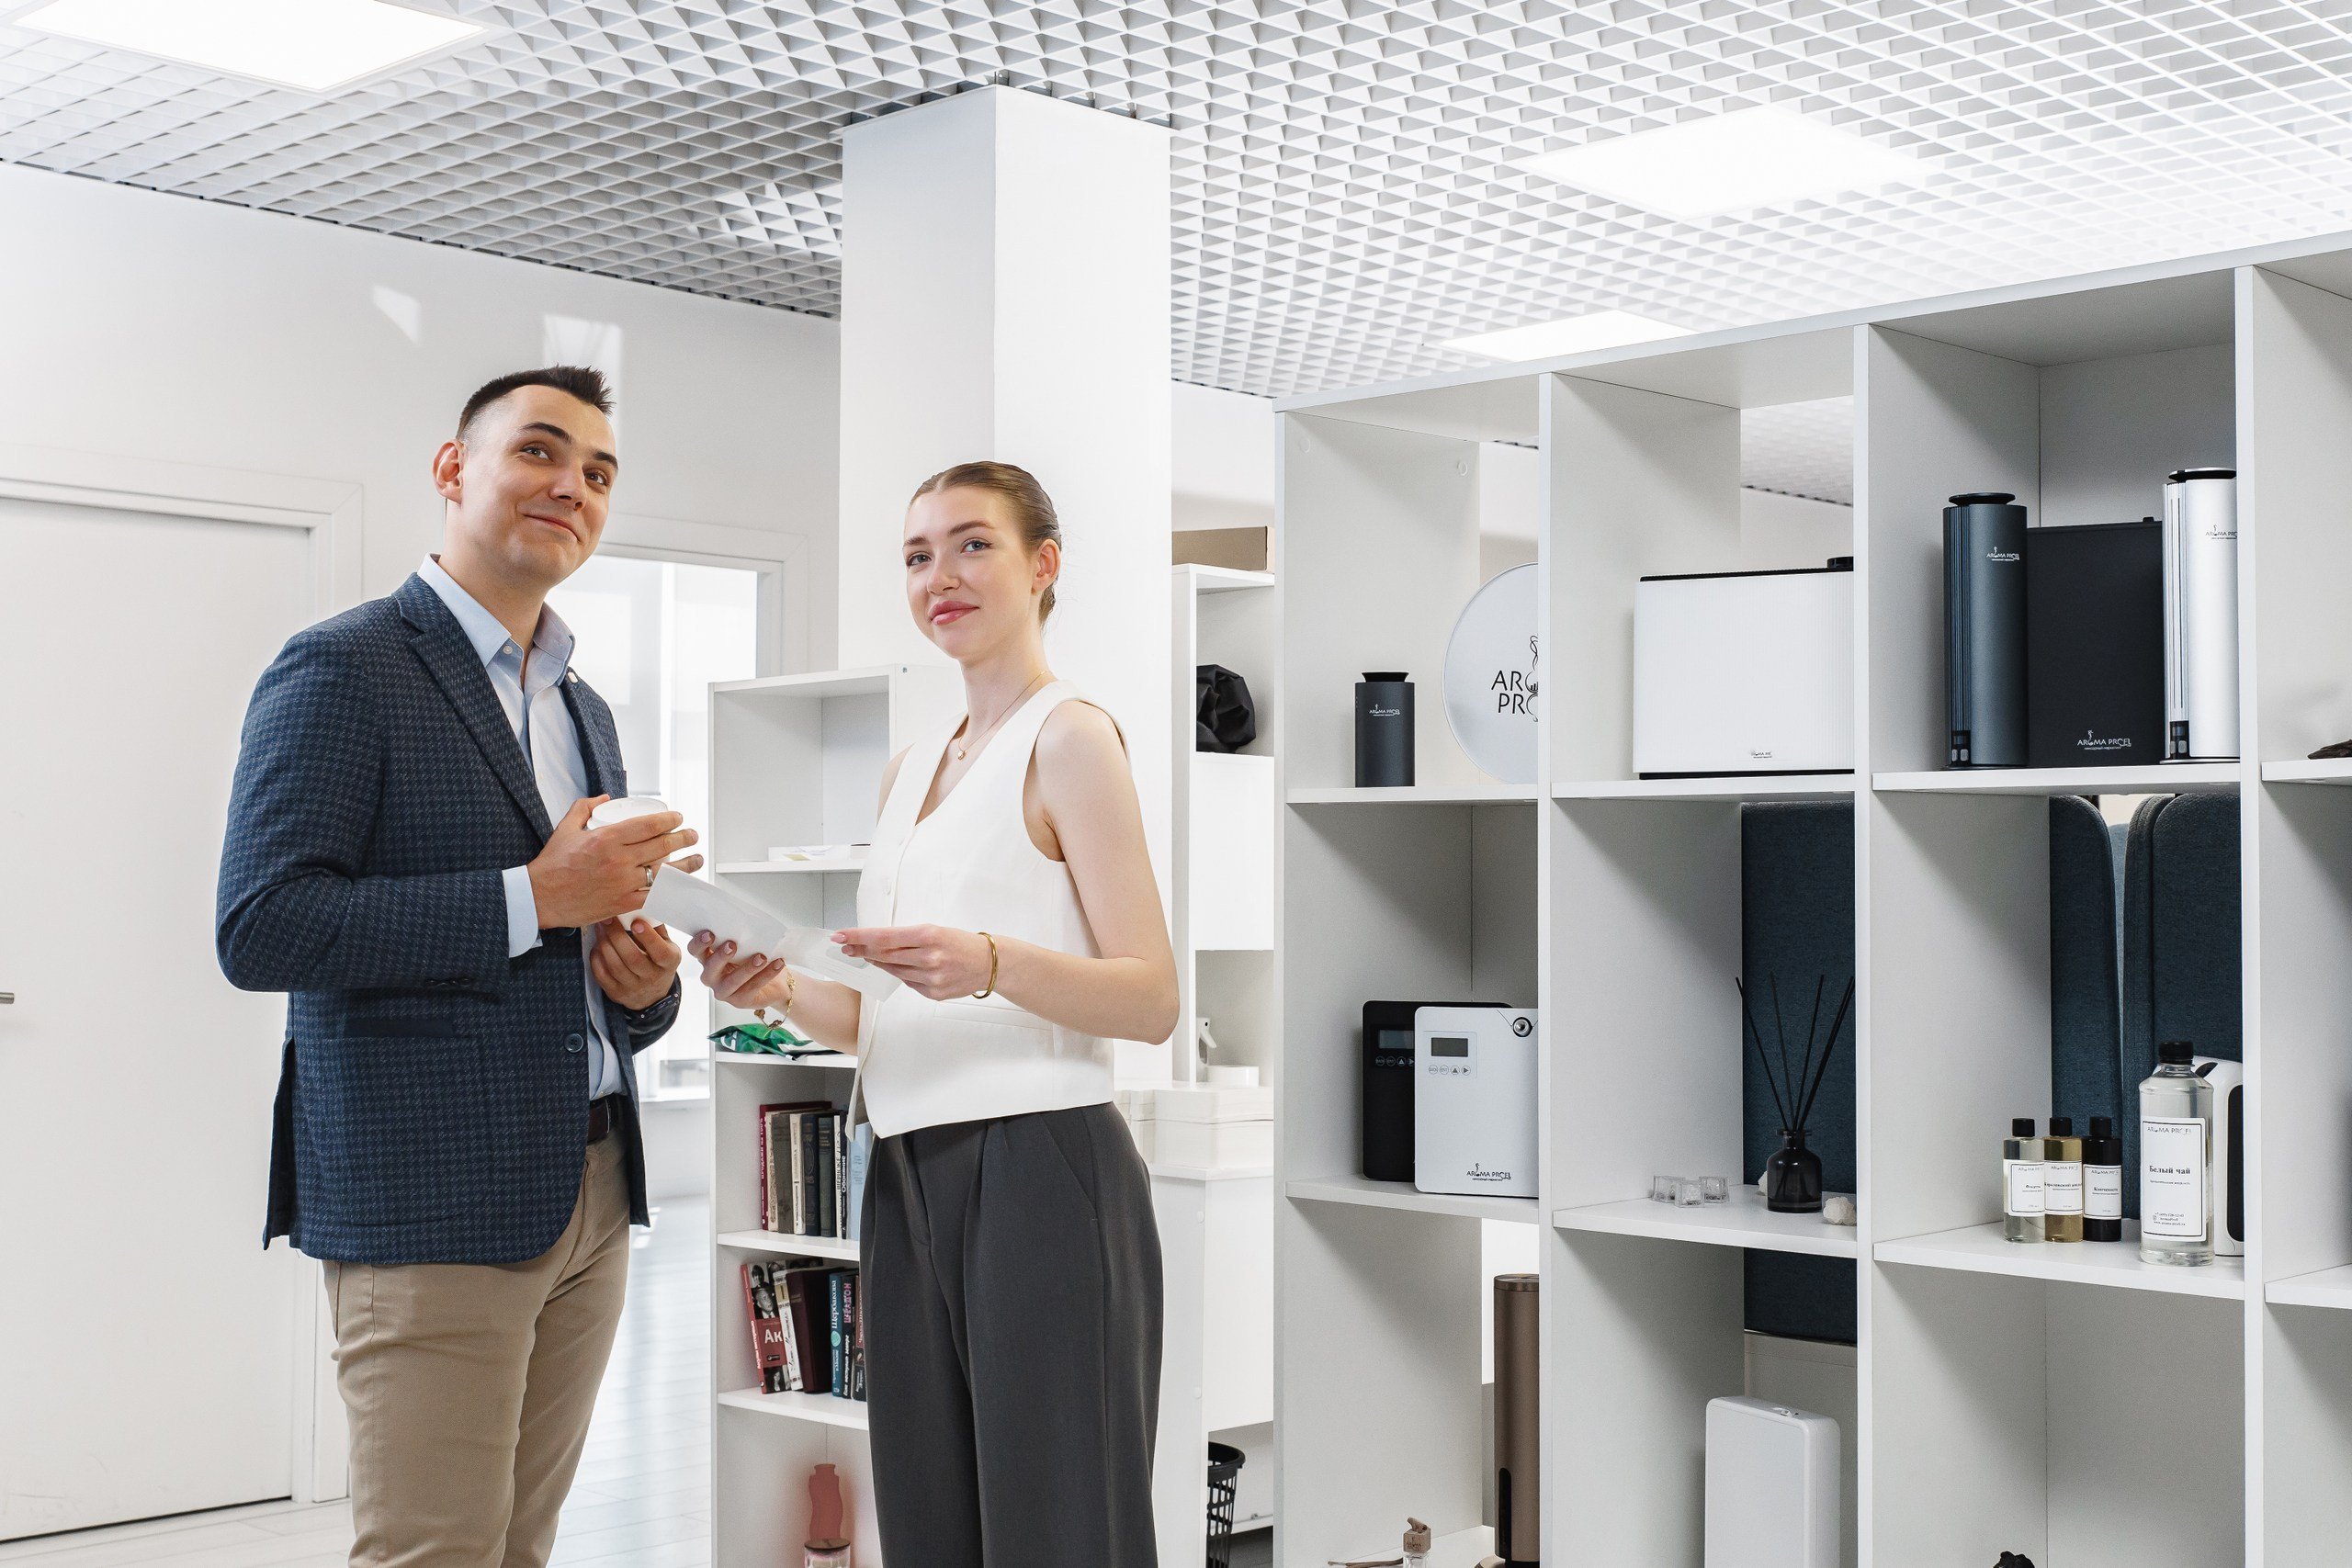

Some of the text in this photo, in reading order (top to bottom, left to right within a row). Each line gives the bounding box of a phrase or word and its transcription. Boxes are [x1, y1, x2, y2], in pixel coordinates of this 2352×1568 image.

[1491, 670, 1539, 694] ARO
[1498, 693, 1539, 716] PRO
[2149, 1166, 2173, 1174] Белый
[764, 1328, 783, 1344] Ак
